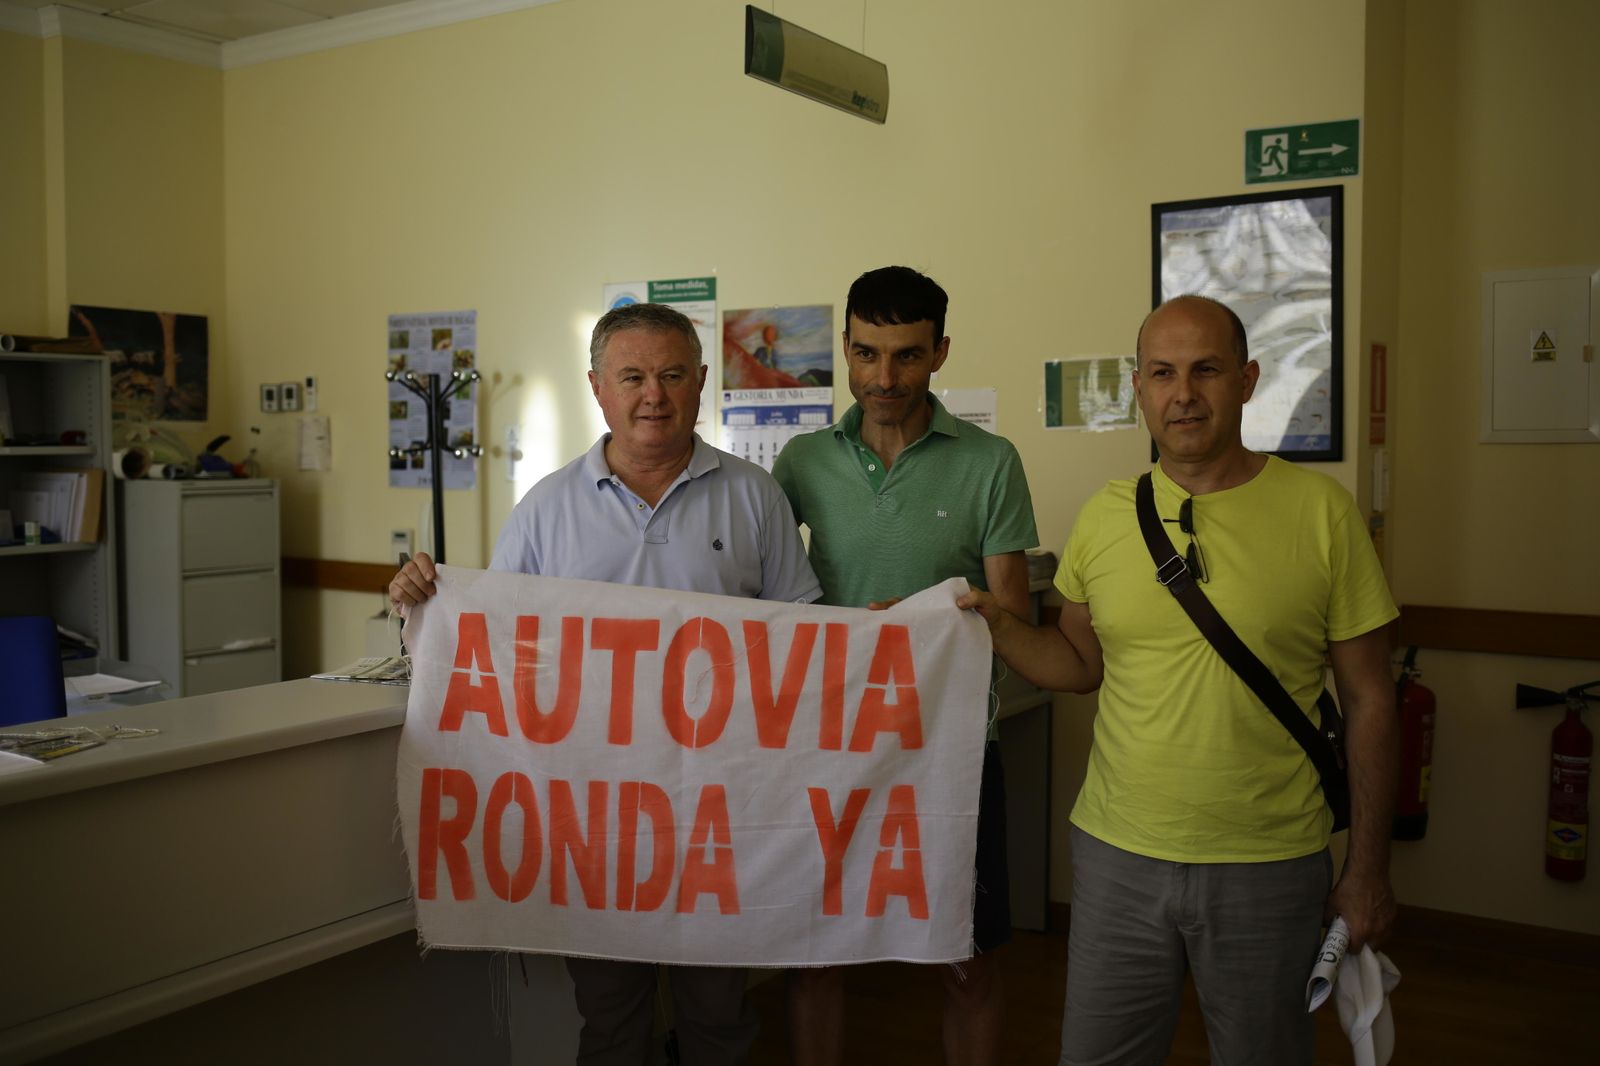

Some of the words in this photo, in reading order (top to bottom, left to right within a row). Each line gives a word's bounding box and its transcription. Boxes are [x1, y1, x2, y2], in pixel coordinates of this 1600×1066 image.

[653, 282, 674, 291] Toma
[733, 391, 773, 401] GESTORIA
[438, 612, 923, 752] AUTOVIA
[418, 768, 740, 915] RONDA
[807, 785, 929, 920] YA
